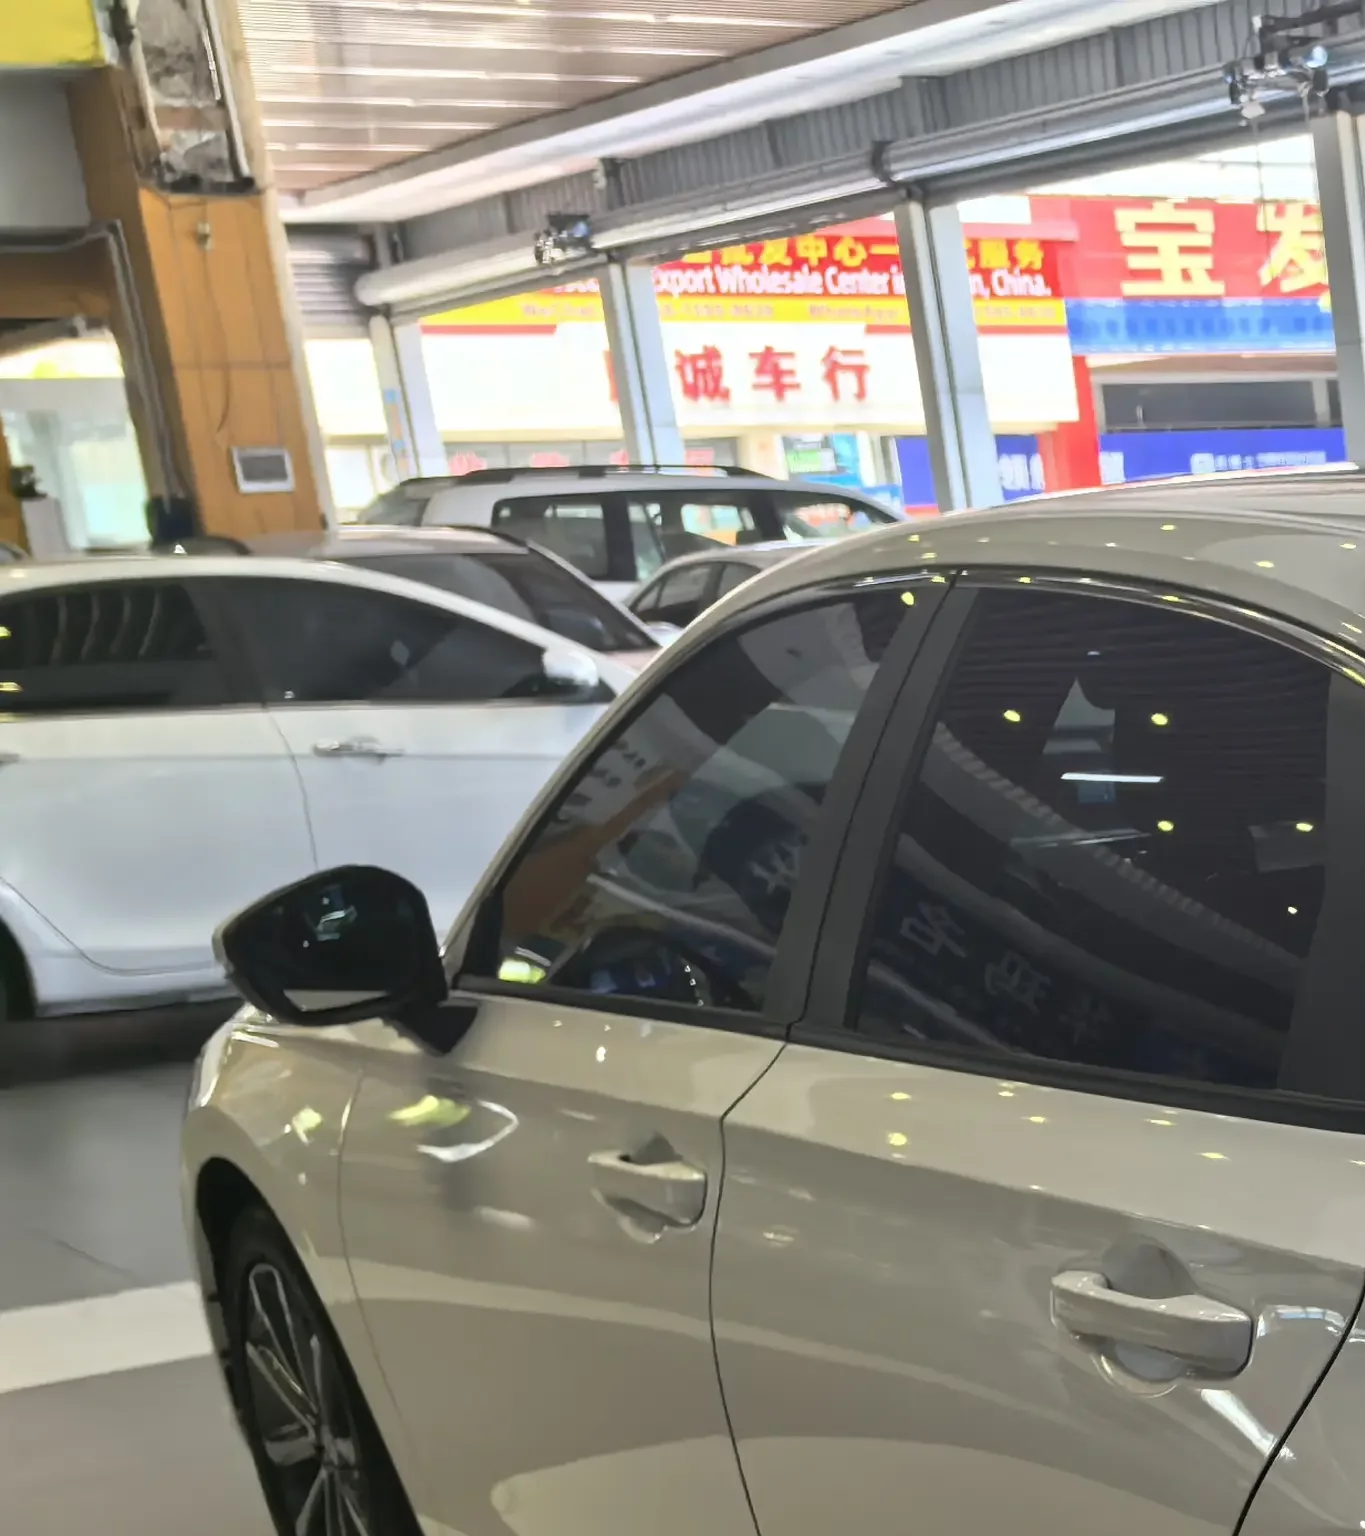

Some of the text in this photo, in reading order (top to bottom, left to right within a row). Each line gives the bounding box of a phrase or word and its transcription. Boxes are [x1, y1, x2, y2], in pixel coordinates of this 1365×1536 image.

[714, 263, 823, 296] Wholesale
[825, 266, 891, 296] Center
[604, 345, 870, 403] 诚车行
